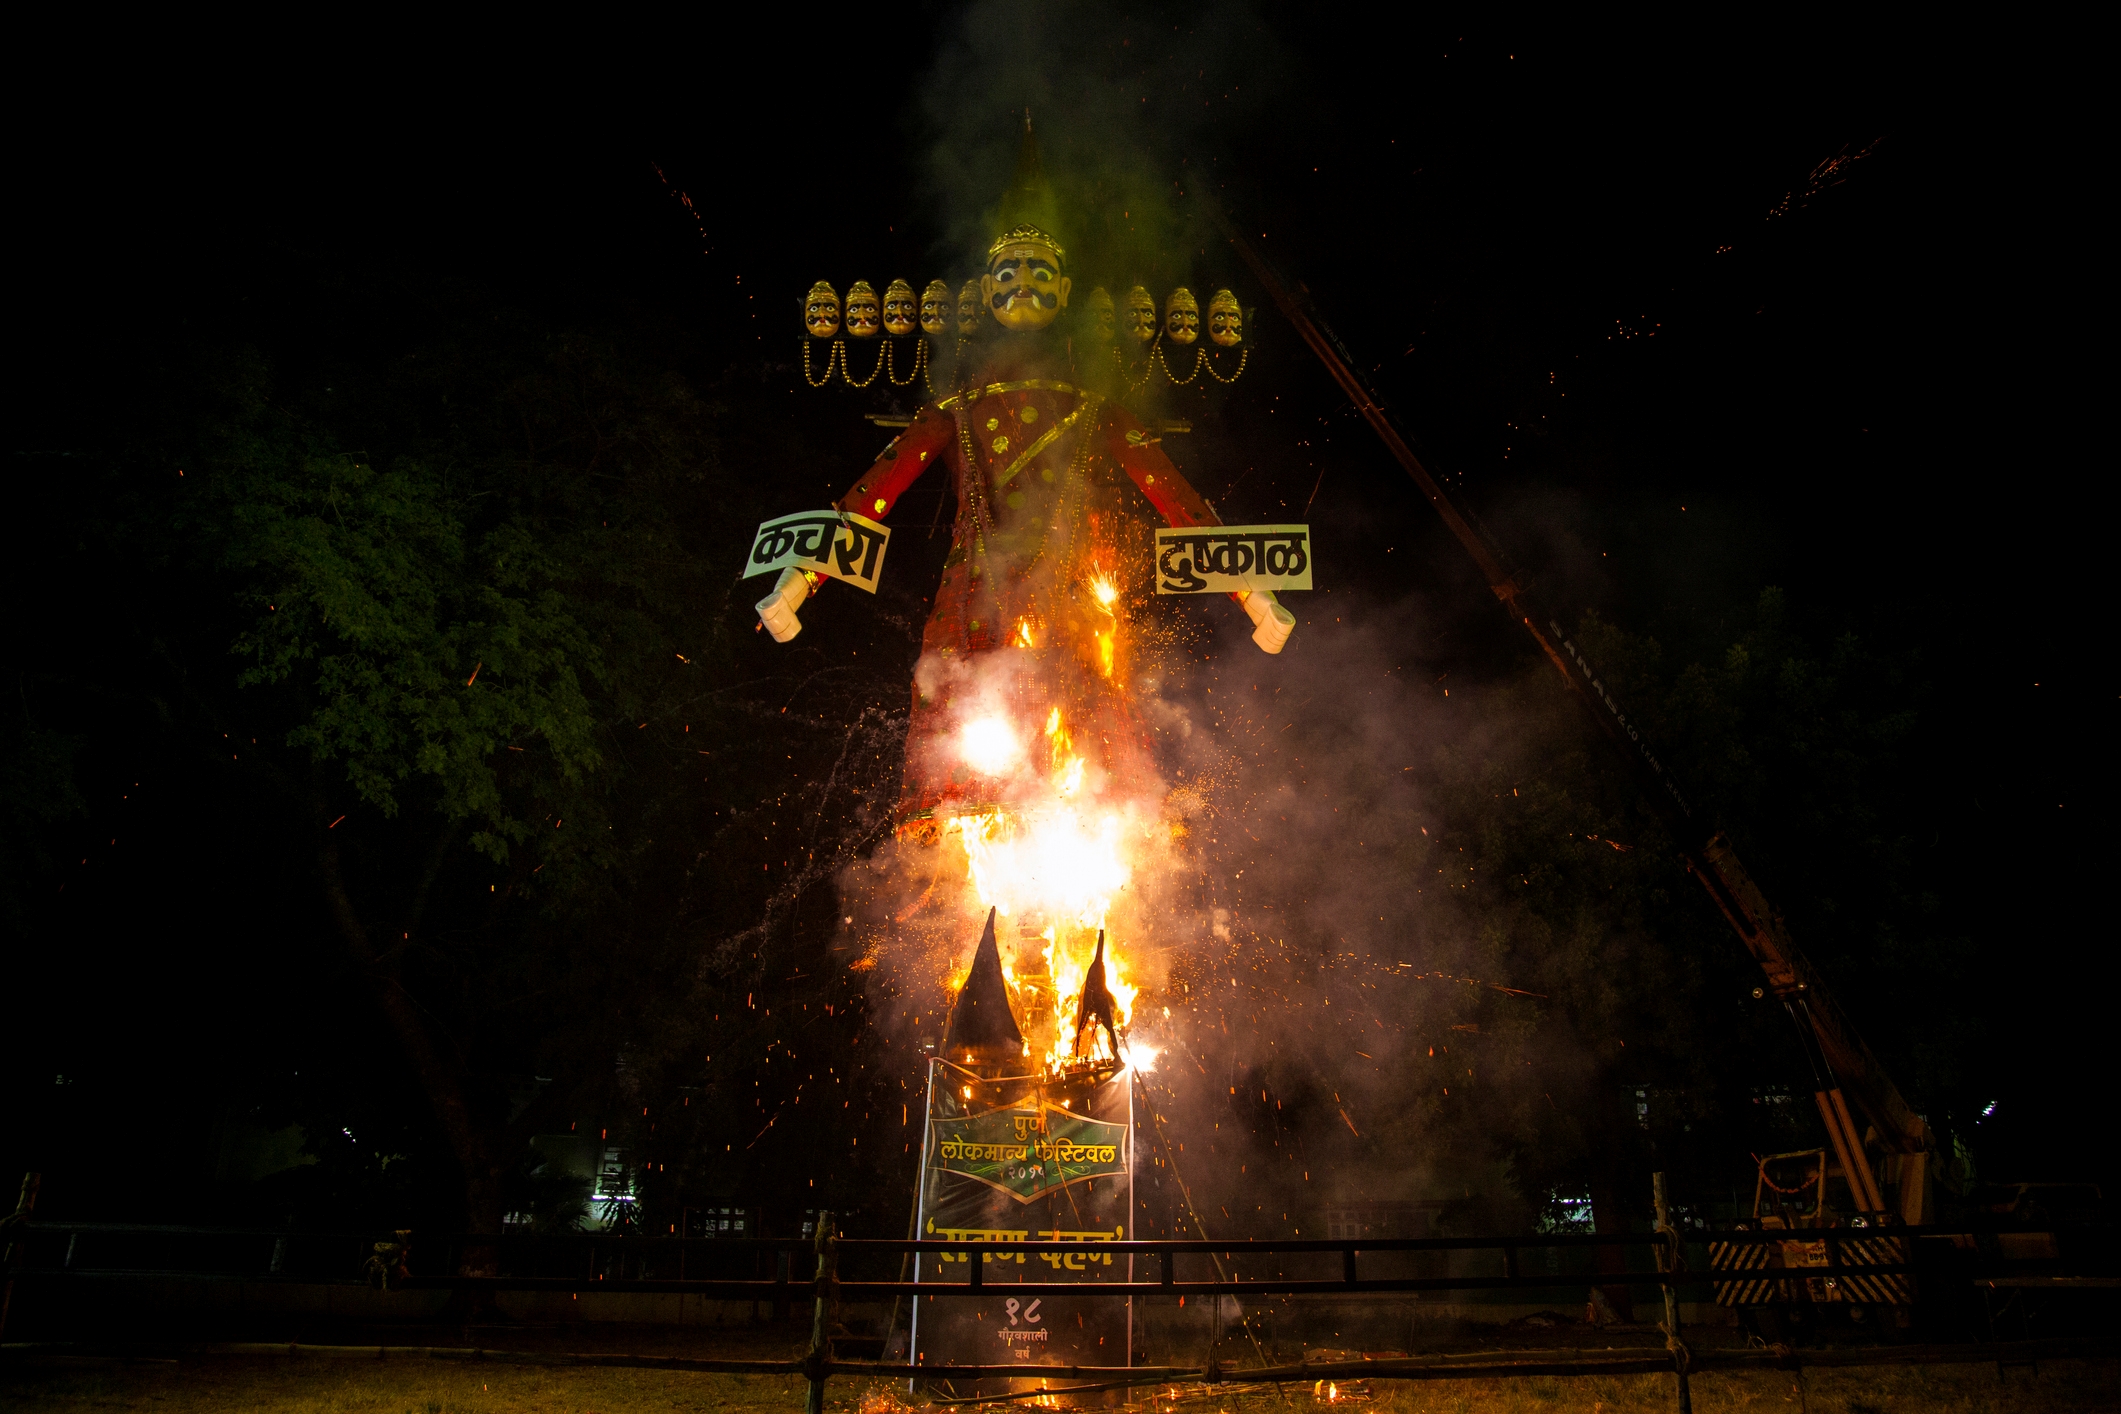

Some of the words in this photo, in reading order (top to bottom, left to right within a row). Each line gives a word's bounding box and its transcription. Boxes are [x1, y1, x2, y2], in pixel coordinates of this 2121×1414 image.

[752, 517, 885, 580] कचरा
[1158, 532, 1307, 592] दुष्काळ
[1665, 777, 1692, 818] SERVICE
[940, 1133, 1030, 1162] लोकमान्य
[1005, 1297, 1042, 1326] १८
[997, 1326, 1049, 1342] गौरवशाली
[1014, 1345, 1031, 1360] वर्ष
